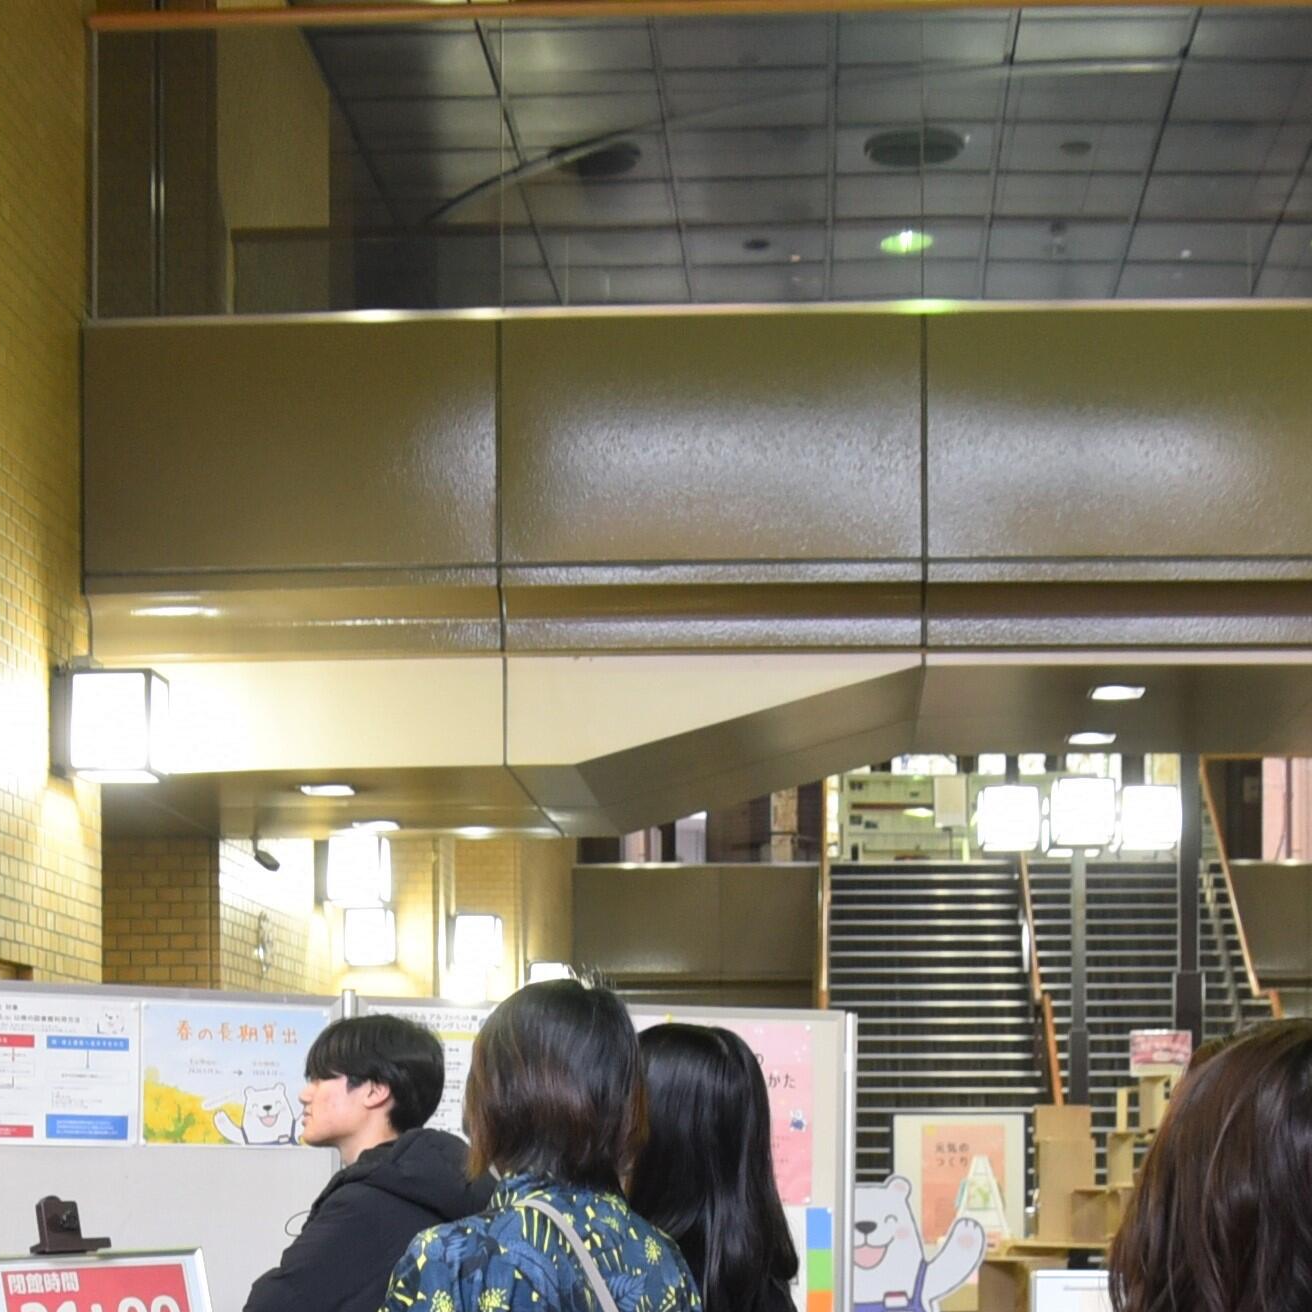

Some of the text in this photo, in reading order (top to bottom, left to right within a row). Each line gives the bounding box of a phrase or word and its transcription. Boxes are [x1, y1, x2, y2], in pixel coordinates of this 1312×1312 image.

[177, 1019, 297, 1045] 春の長期貸出
[7, 1271, 80, 1296] 閉館時間
